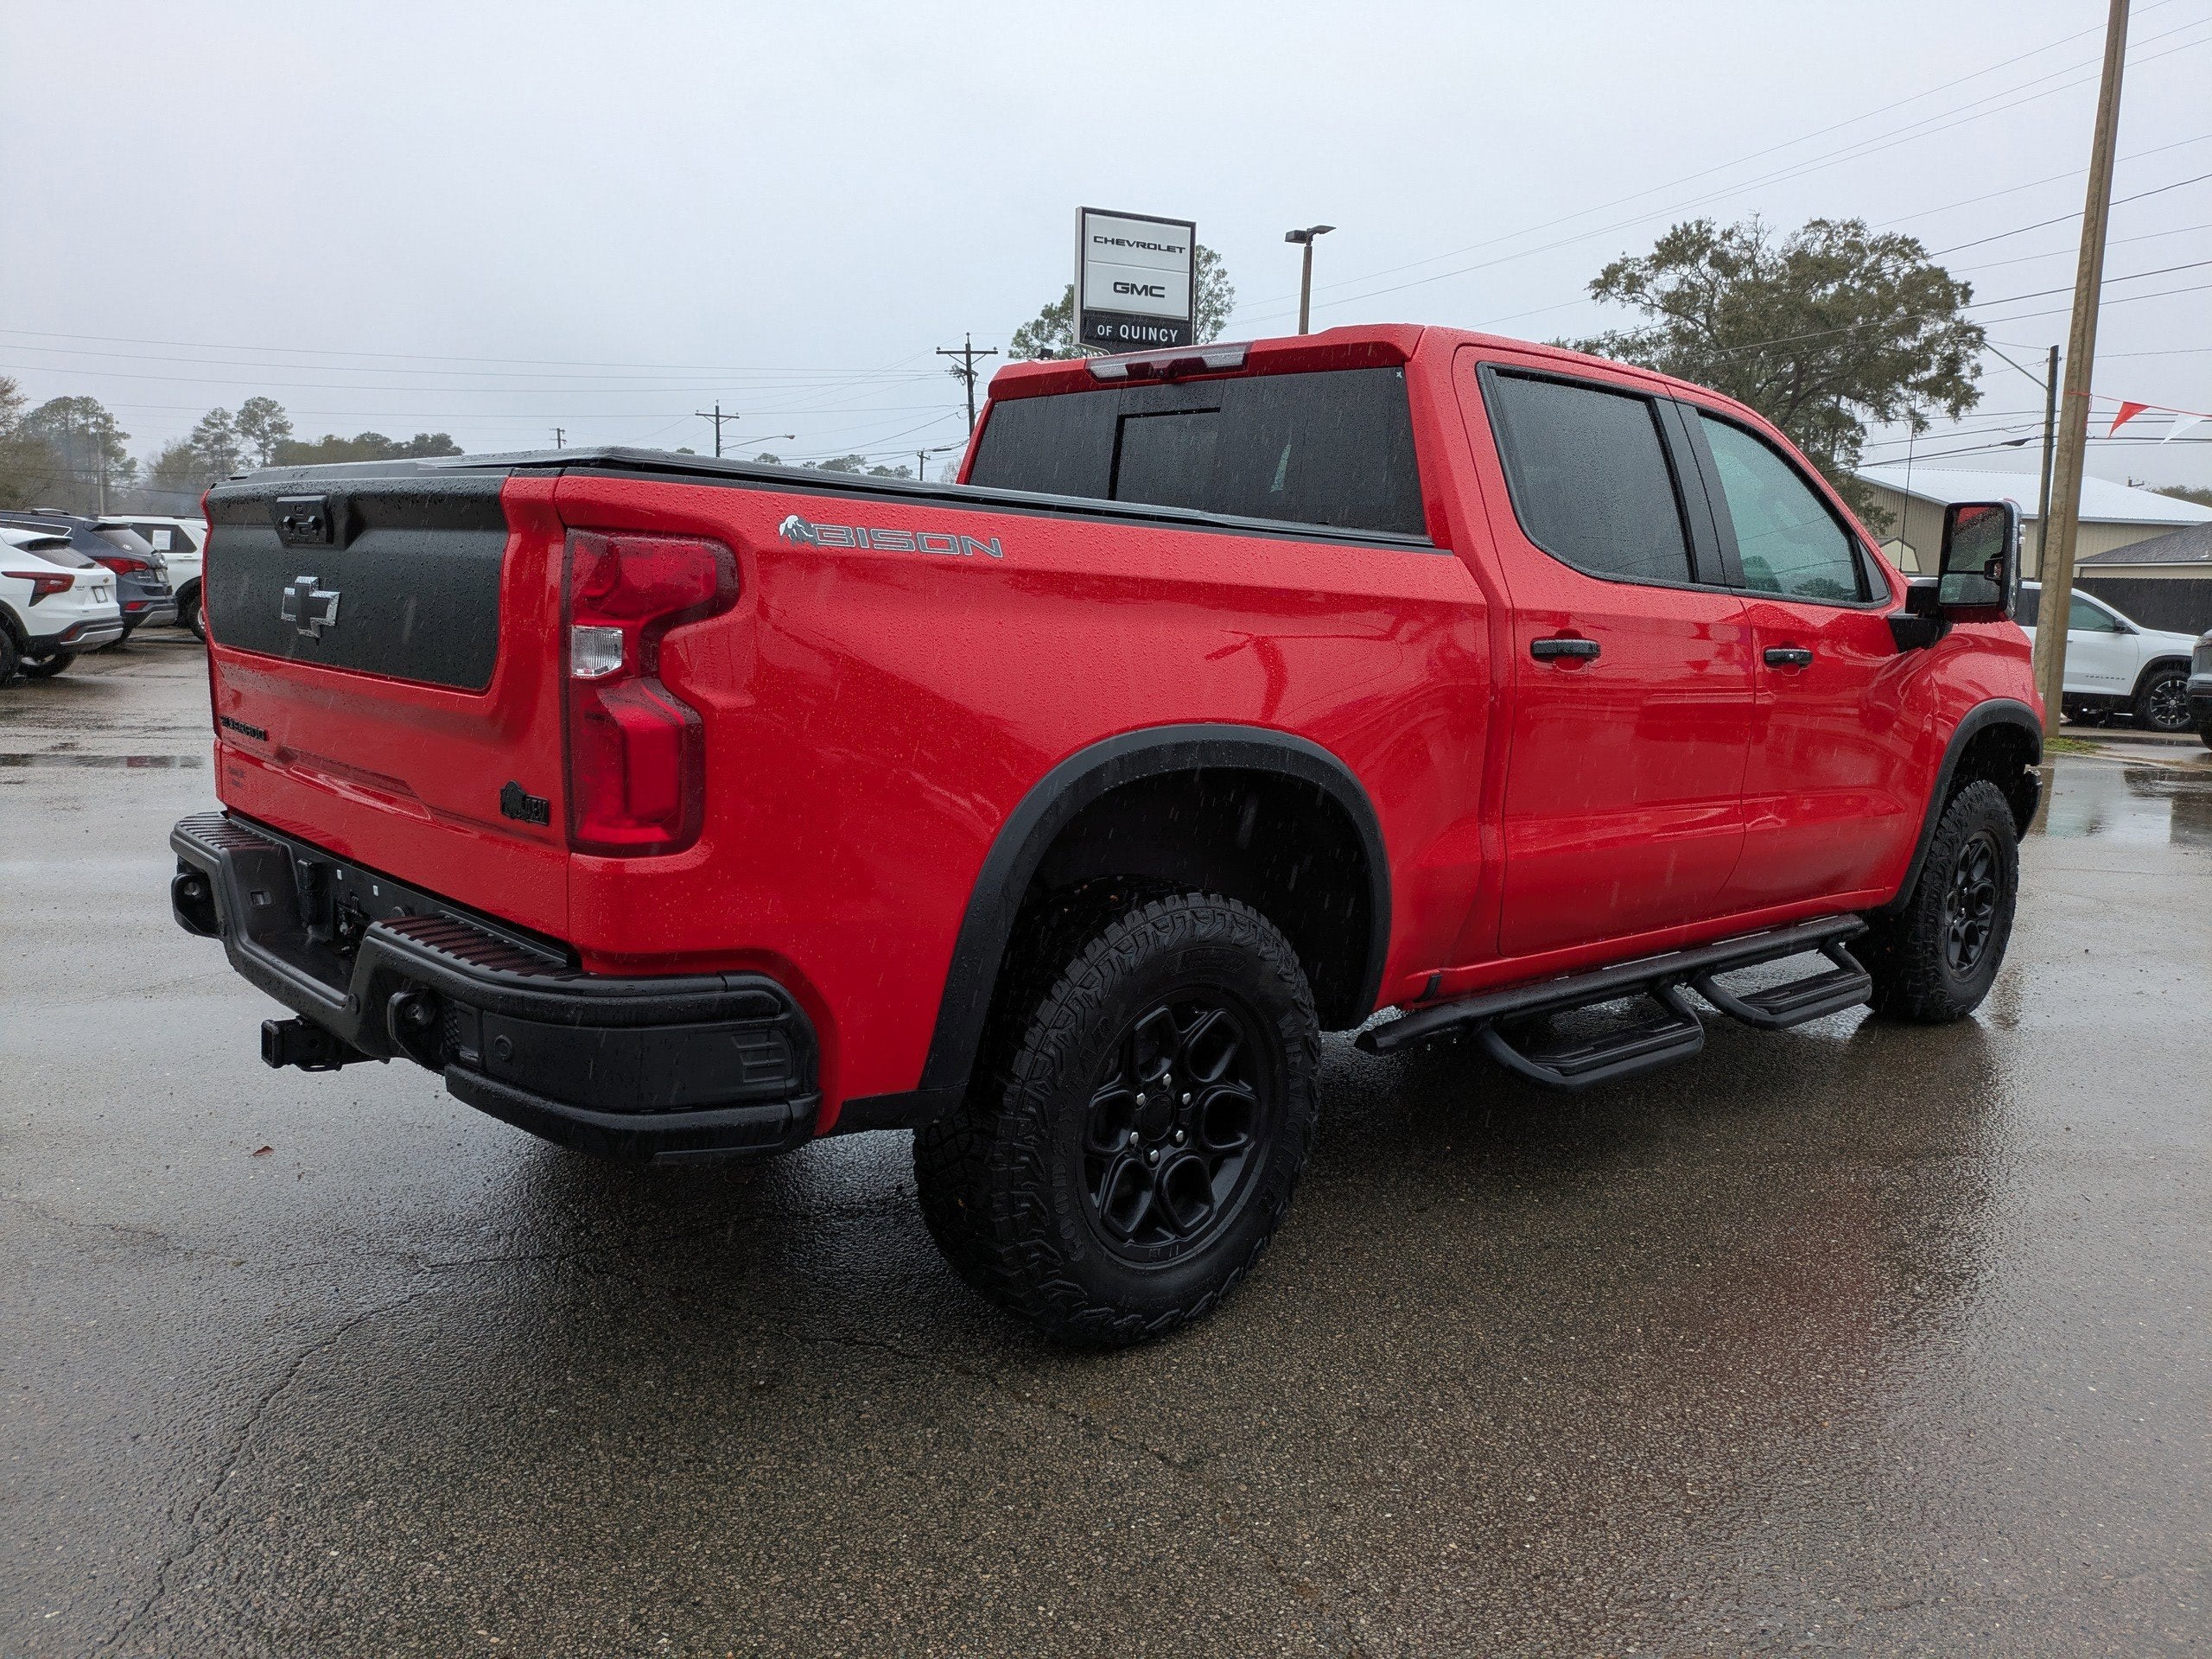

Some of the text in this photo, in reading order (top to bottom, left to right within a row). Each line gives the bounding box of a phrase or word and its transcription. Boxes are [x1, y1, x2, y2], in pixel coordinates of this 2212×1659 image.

[1093, 235, 1186, 254] CHEVROLET
[1113, 281, 1166, 299] GMC
[1096, 324, 1179, 343] OF QUINCY
[812, 524, 1003, 558] BISON
